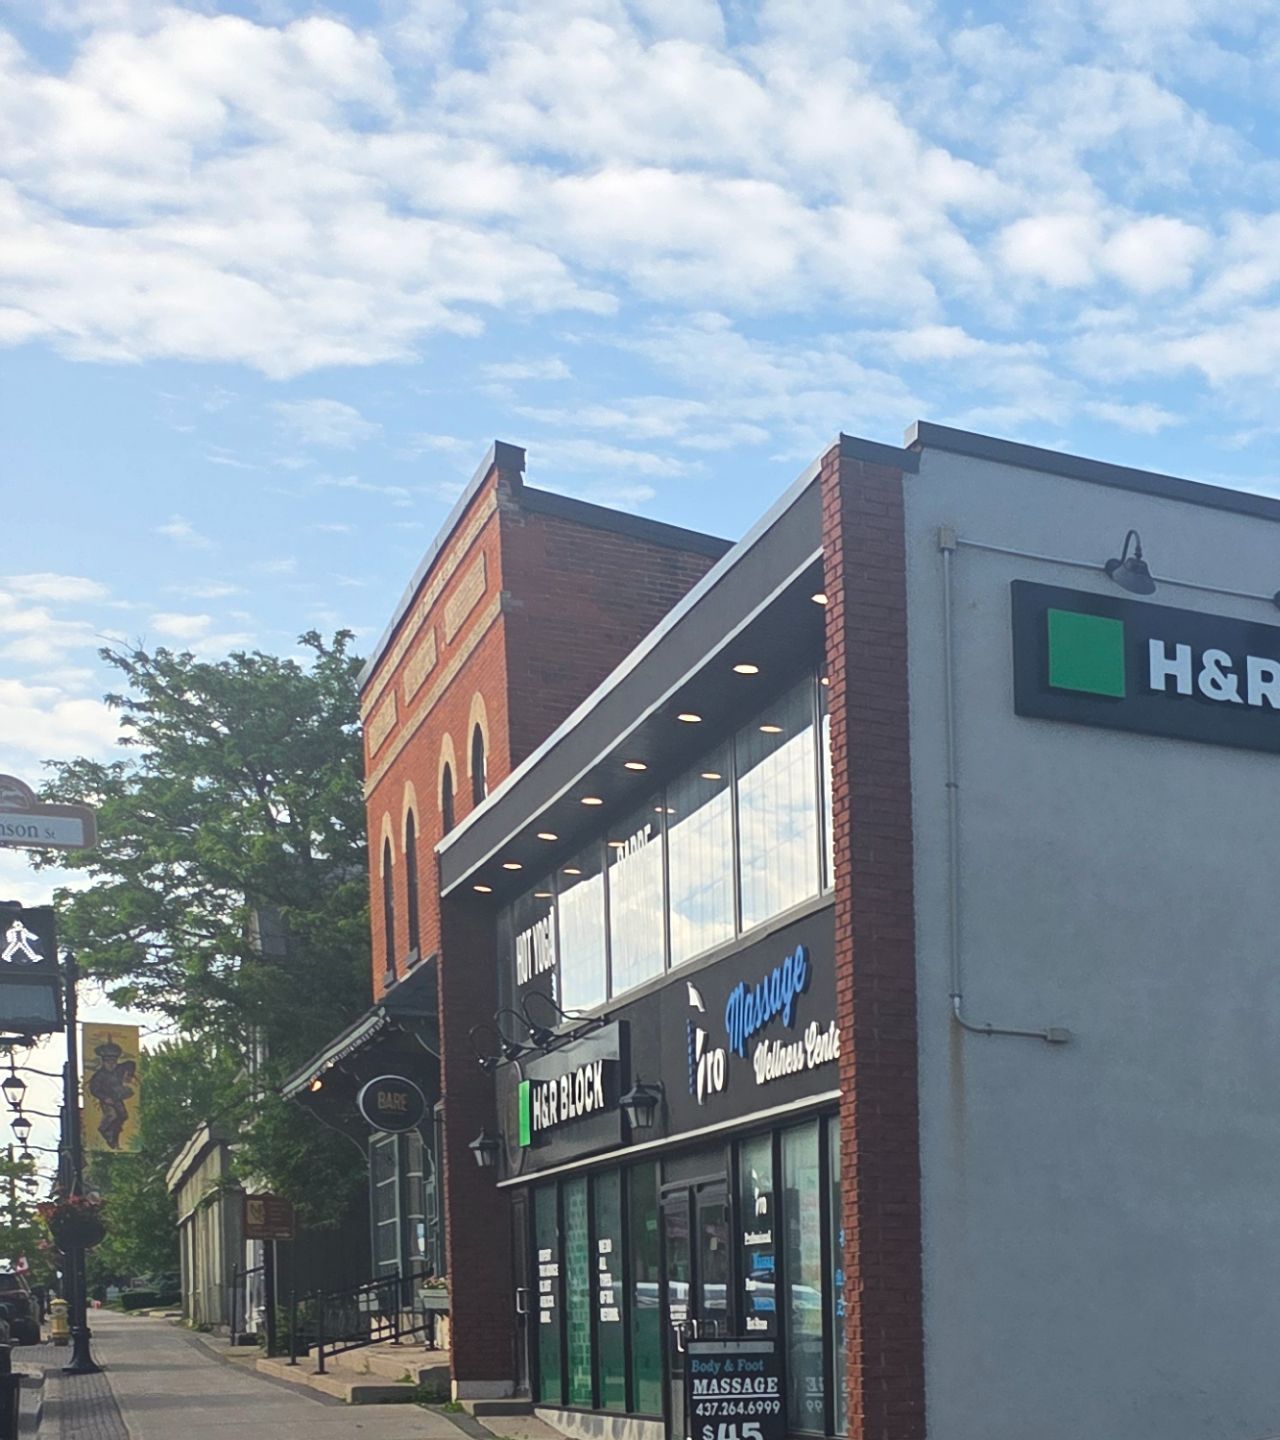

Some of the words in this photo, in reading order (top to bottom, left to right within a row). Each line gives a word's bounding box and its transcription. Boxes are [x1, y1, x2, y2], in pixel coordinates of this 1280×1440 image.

[725, 944, 806, 1058] Massage
[754, 1039, 804, 1085] Wellness
[804, 1020, 840, 1069] Cente
[533, 1080, 558, 1131] H&R
[560, 1059, 604, 1121] BLOCK
[691, 1360, 721, 1374] Body
[724, 1359, 735, 1372] &
[737, 1359, 764, 1372] Foot
[692, 1377, 778, 1395] MASSAGE
[696, 1400, 780, 1416] 437.264.6999
